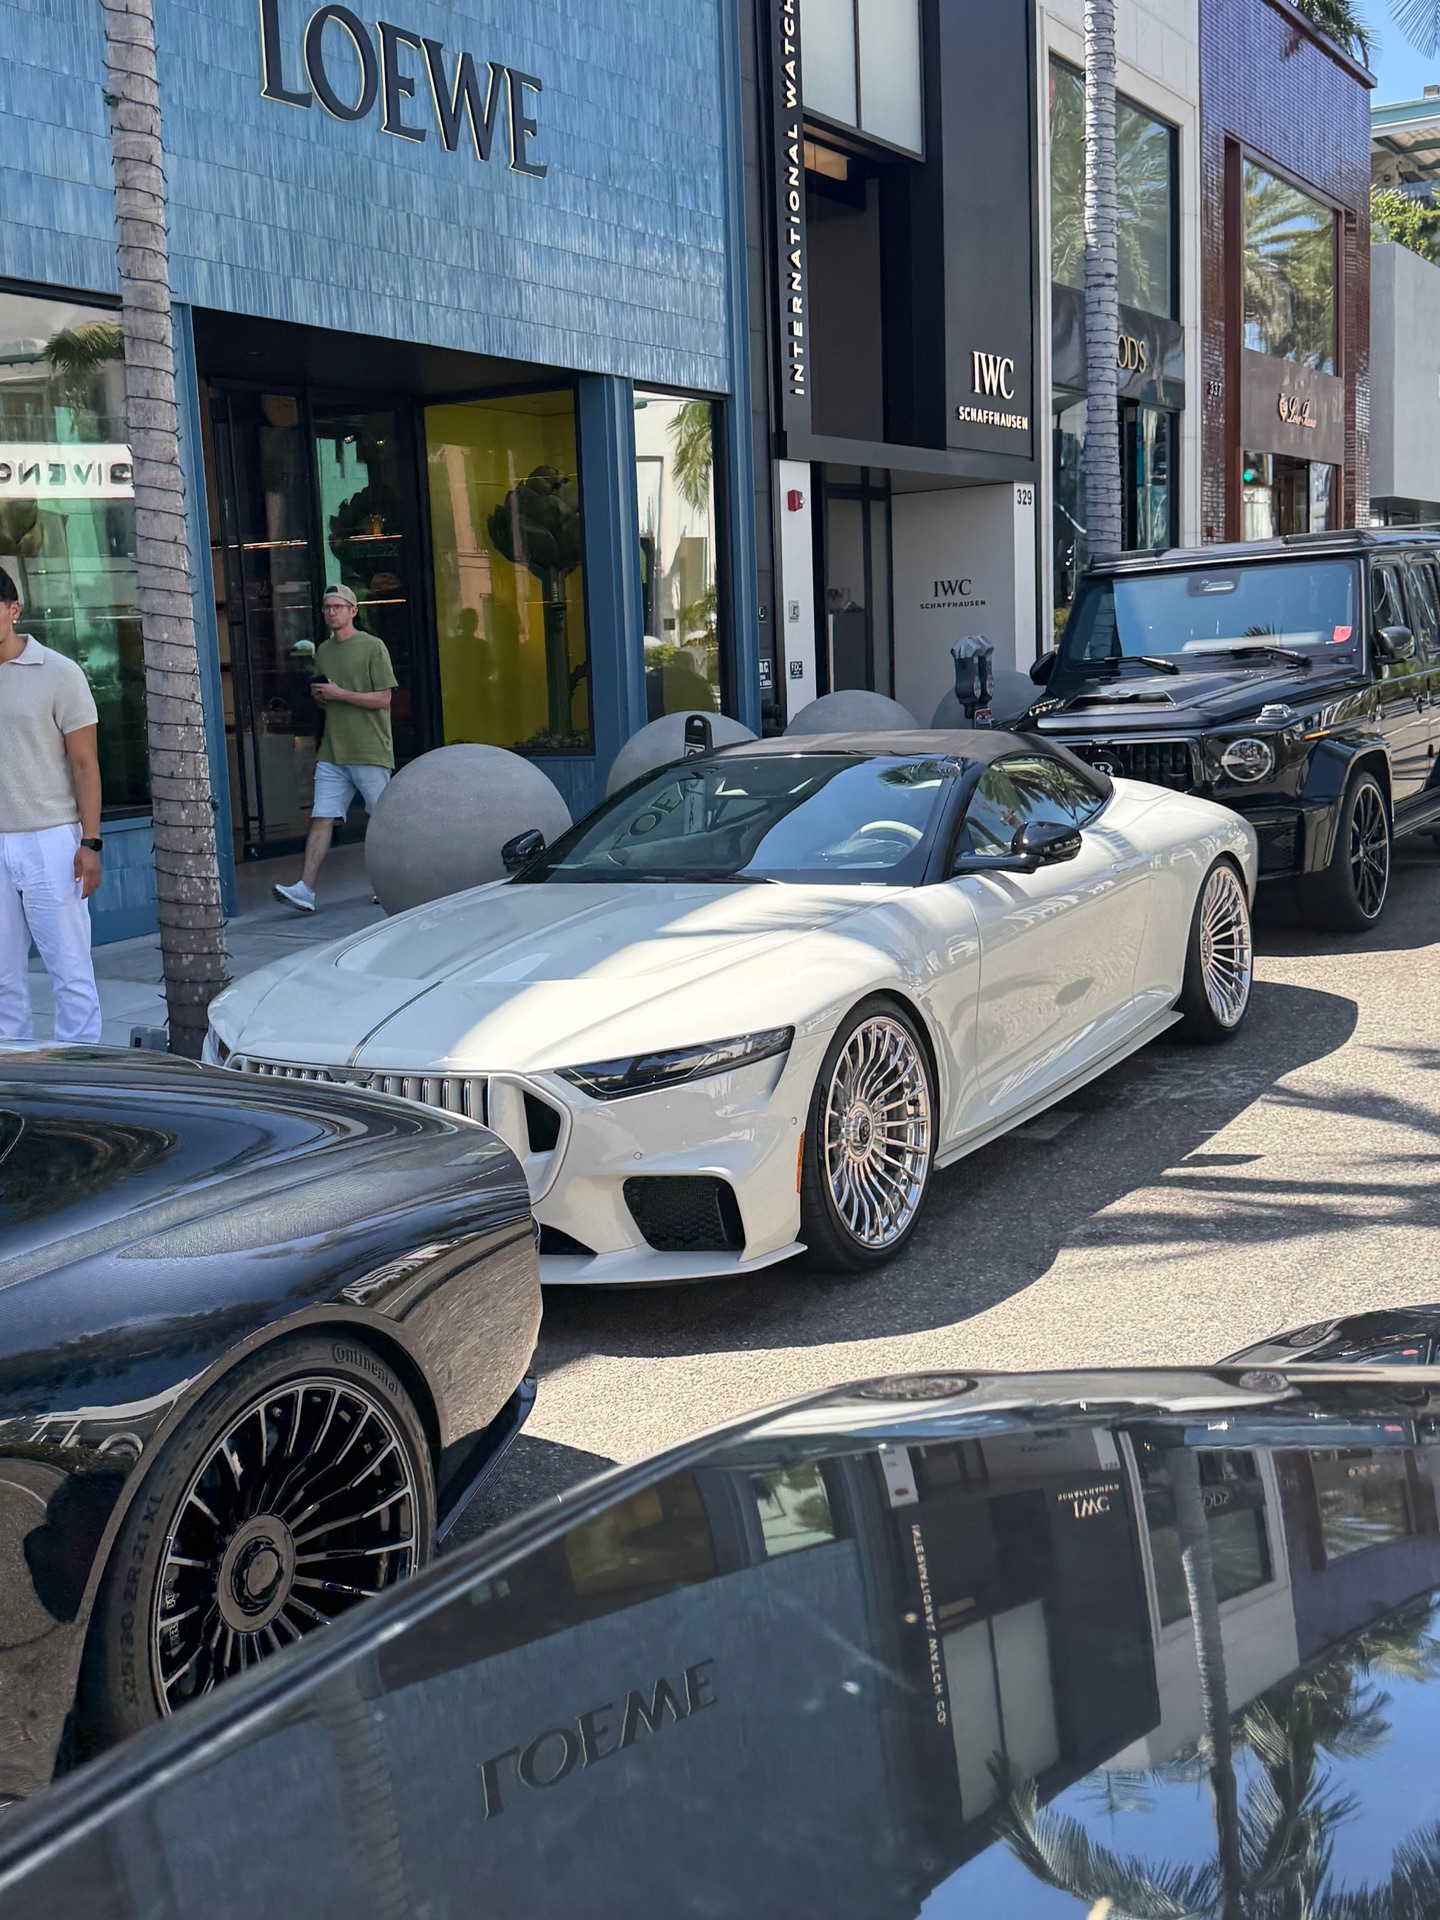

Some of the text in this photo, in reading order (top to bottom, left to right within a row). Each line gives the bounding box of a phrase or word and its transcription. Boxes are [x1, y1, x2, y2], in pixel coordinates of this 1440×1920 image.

[259, 0, 548, 179] LOEWE
[783, 0, 804, 396] INTERNATIONAL WATCH
[1117, 334, 1147, 374] OD'S
[972, 350, 1015, 400] IWC
[958, 405, 1028, 430] SCHAFFHAUSEN
[1016, 488, 1032, 506] 329
[919, 600, 986, 610] SCHAFFHAUSEN
[933, 578, 972, 598] IWC
[332, 1342, 399, 1397] Continental
